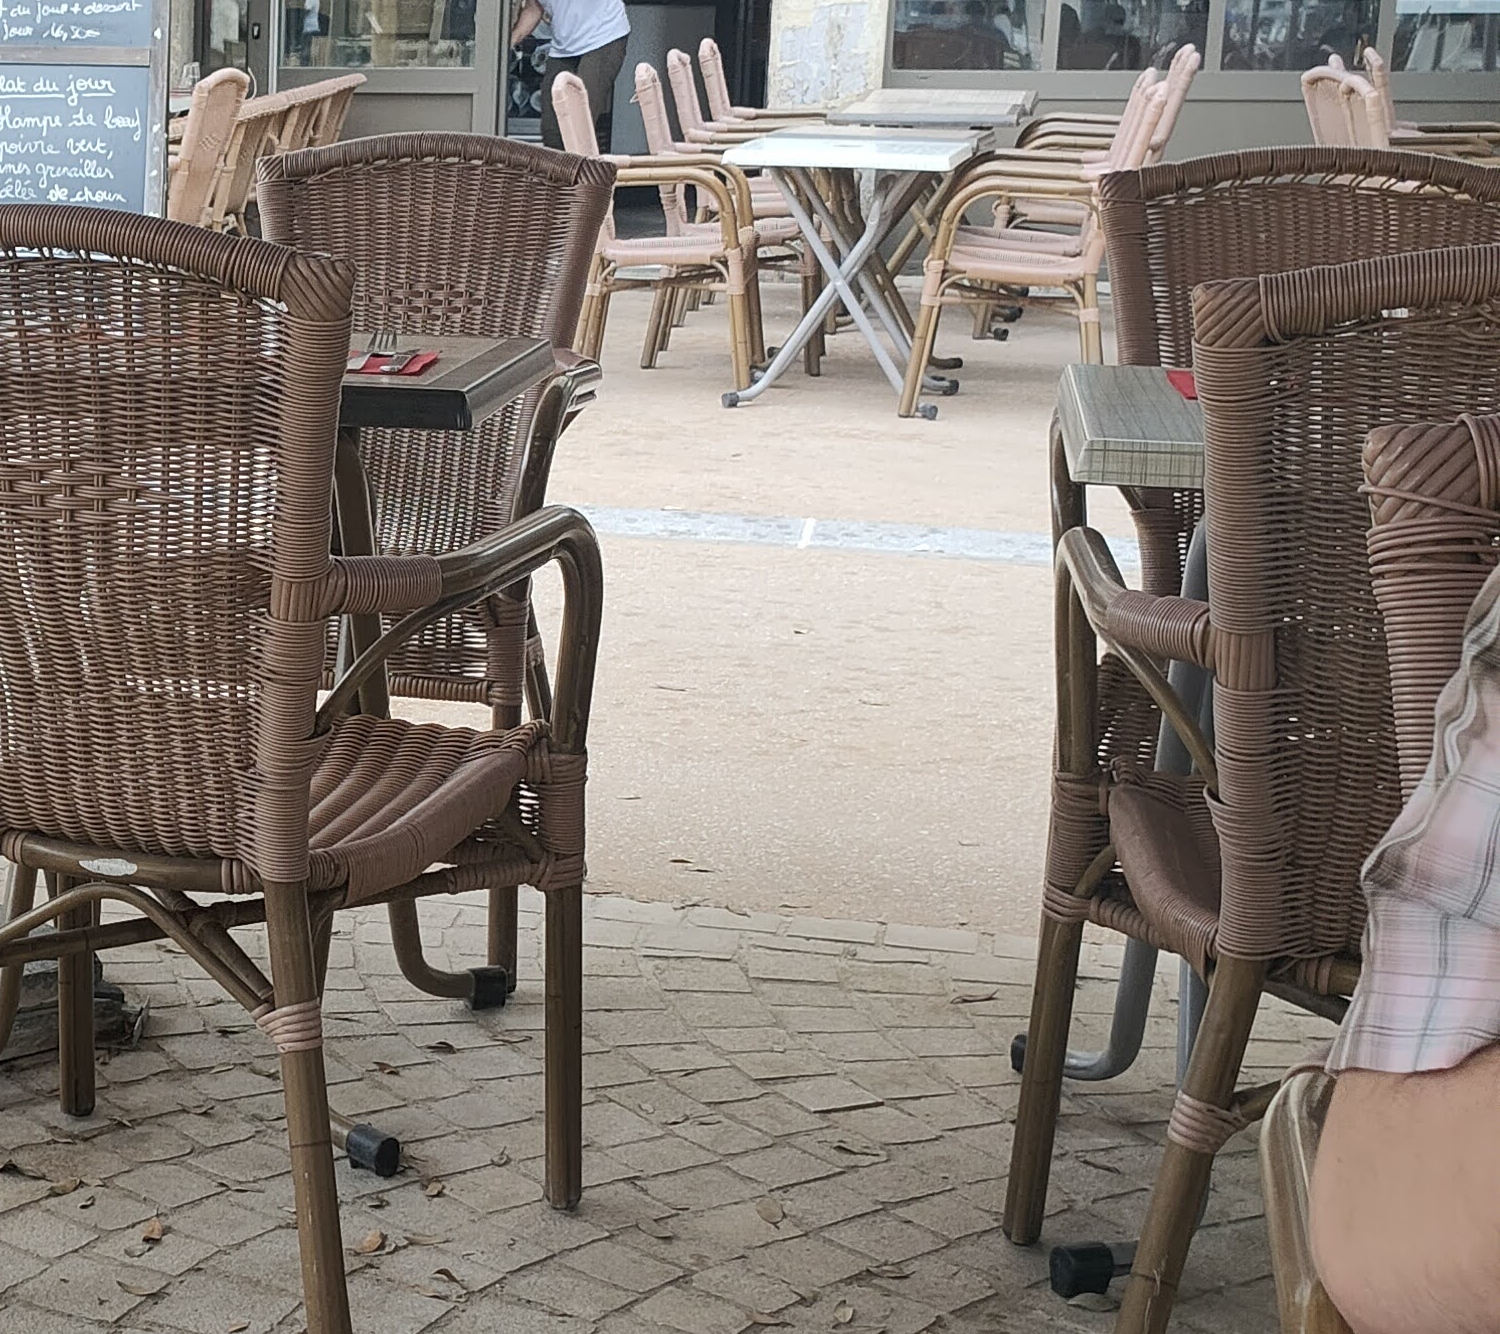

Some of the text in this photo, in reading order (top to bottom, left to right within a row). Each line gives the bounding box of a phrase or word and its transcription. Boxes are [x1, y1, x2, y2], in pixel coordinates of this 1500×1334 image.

[10, 3, 31, 18] du
[33, 76, 60, 94] du
[66, 74, 116, 106] jour
